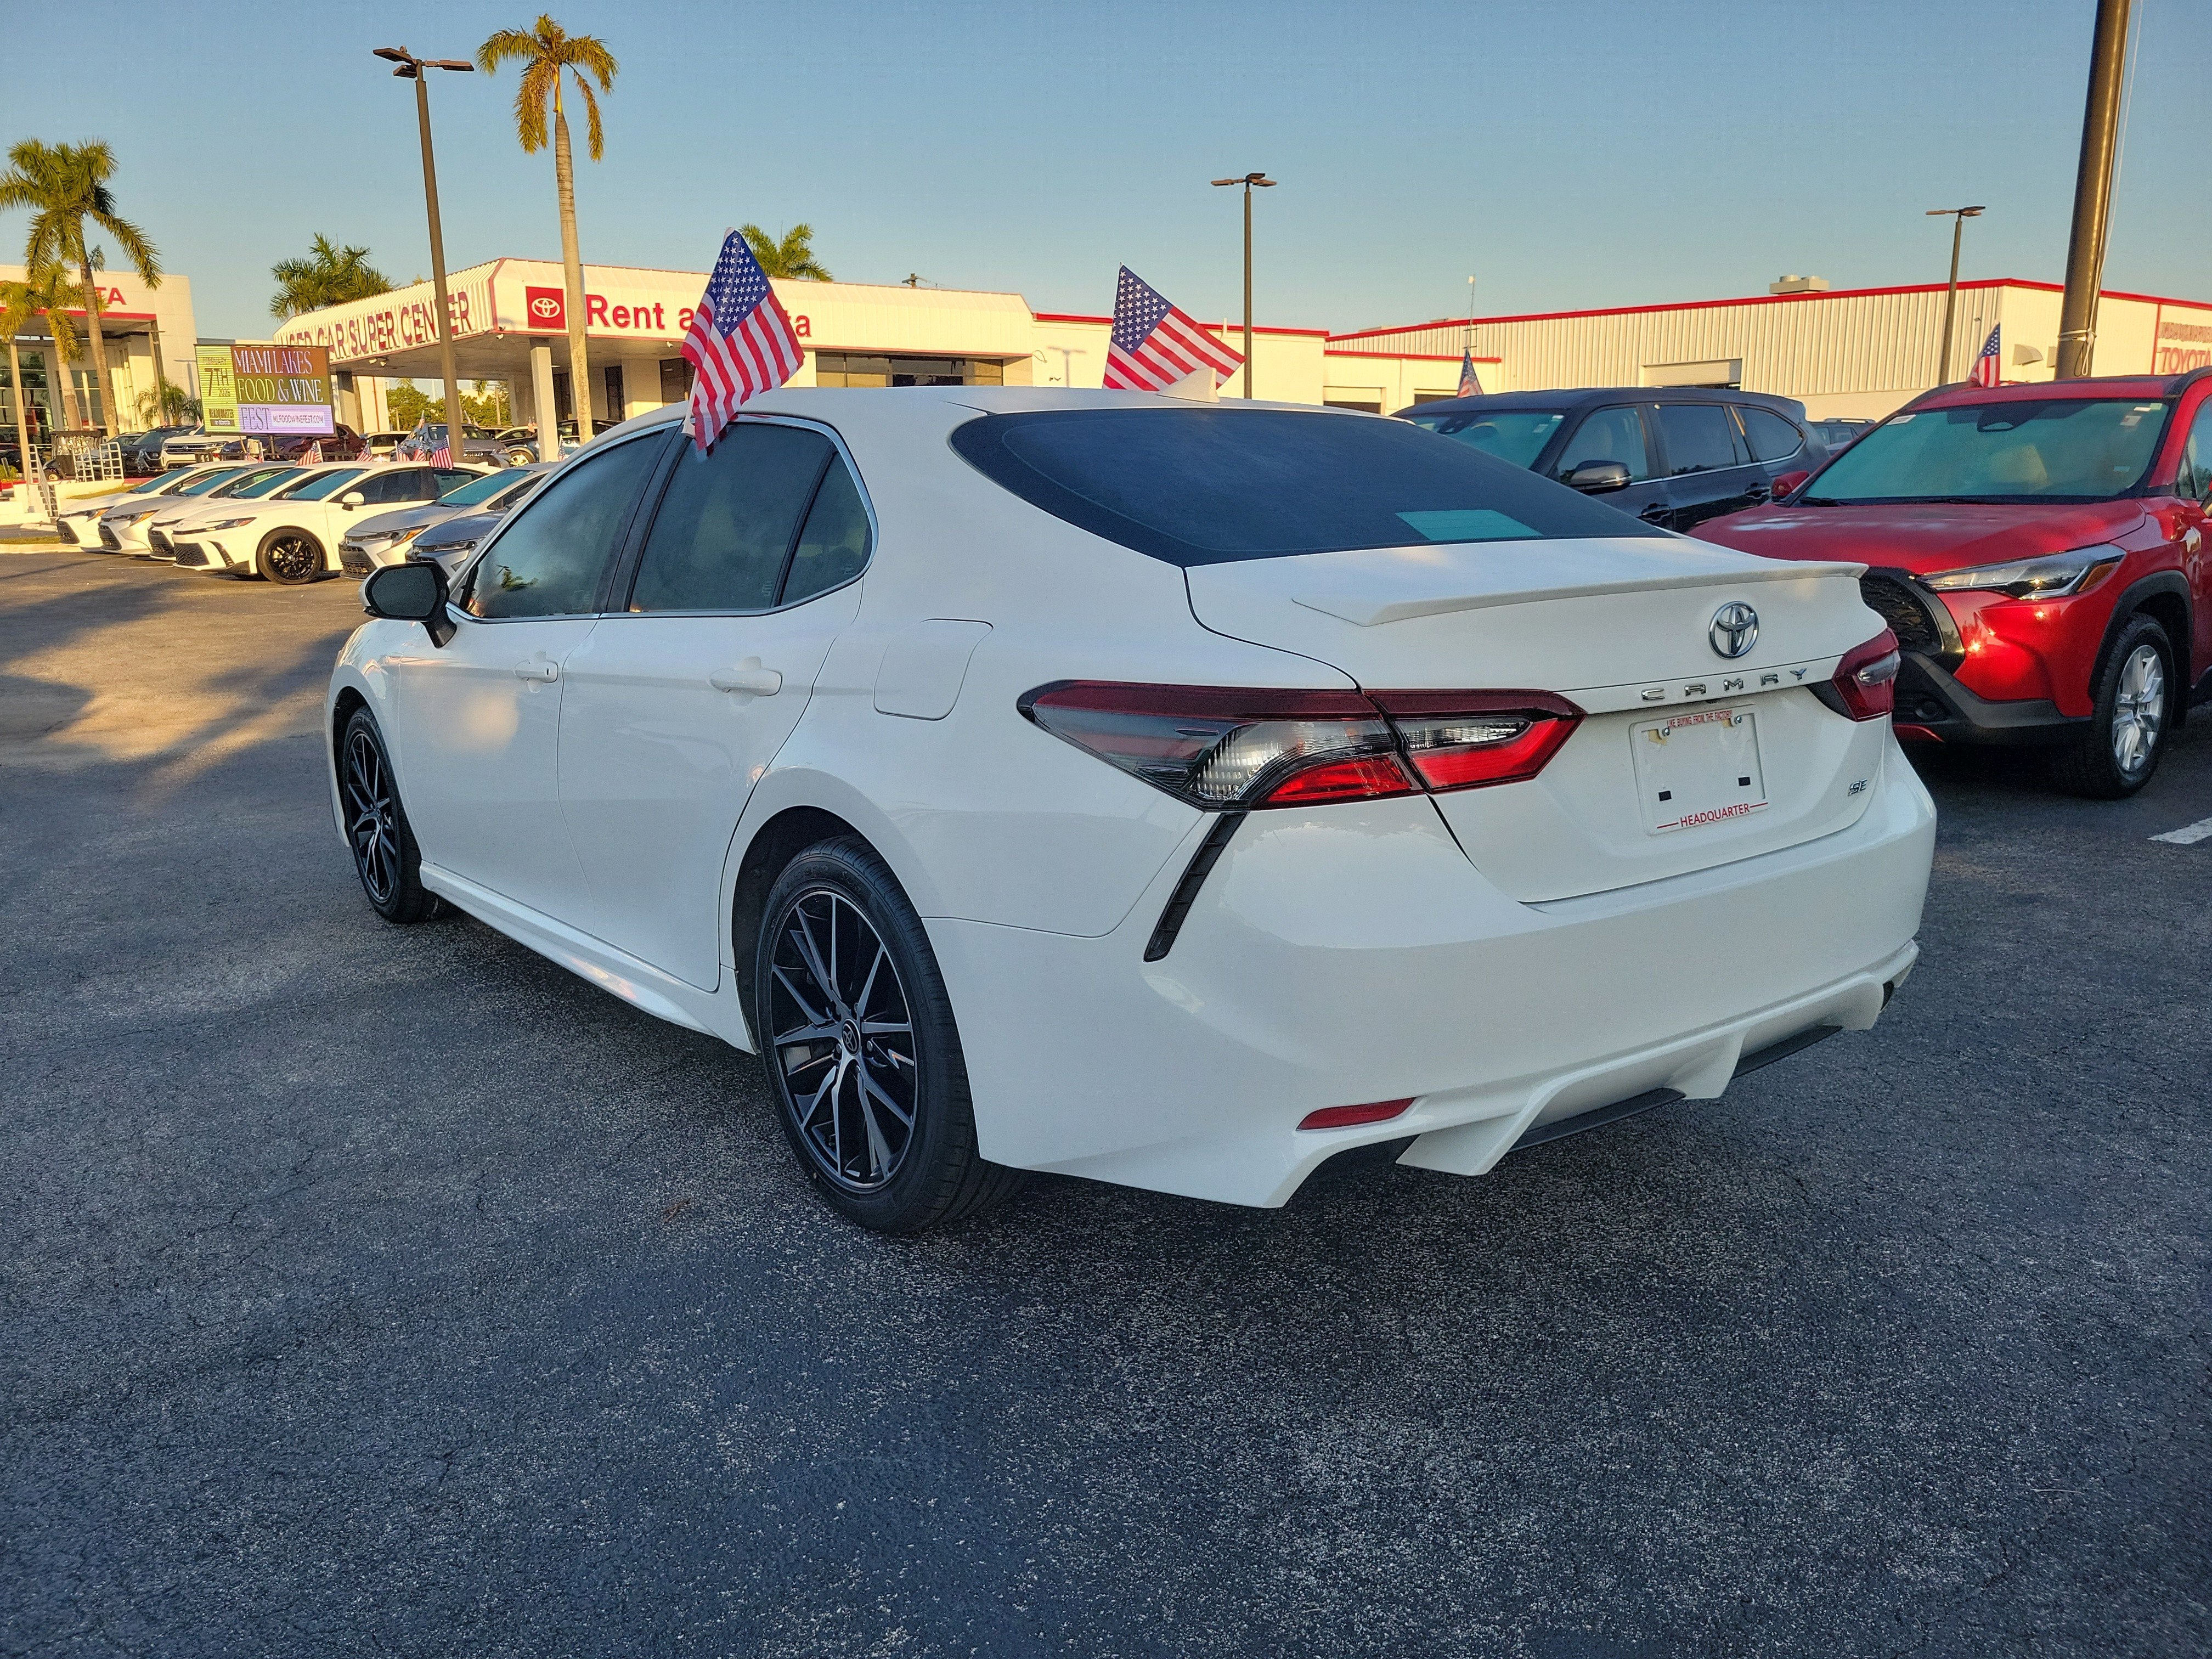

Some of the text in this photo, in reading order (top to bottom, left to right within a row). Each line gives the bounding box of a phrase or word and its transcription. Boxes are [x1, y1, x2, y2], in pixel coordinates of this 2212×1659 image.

[585, 294, 665, 330] Rent
[318, 291, 473, 359] CAR SUPER CENER
[234, 350, 313, 374] MIAMI LAKES
[205, 368, 229, 397] 7TH
[238, 378, 324, 403] FOOD & WINE
[241, 407, 269, 431] FEST
[273, 414, 324, 424] MLFOODWINEFEST.COM
[1641, 668, 1807, 702] CAMRY
[1848, 779, 1867, 795] SE
[1680, 803, 1751, 828] HEADQUARTER
